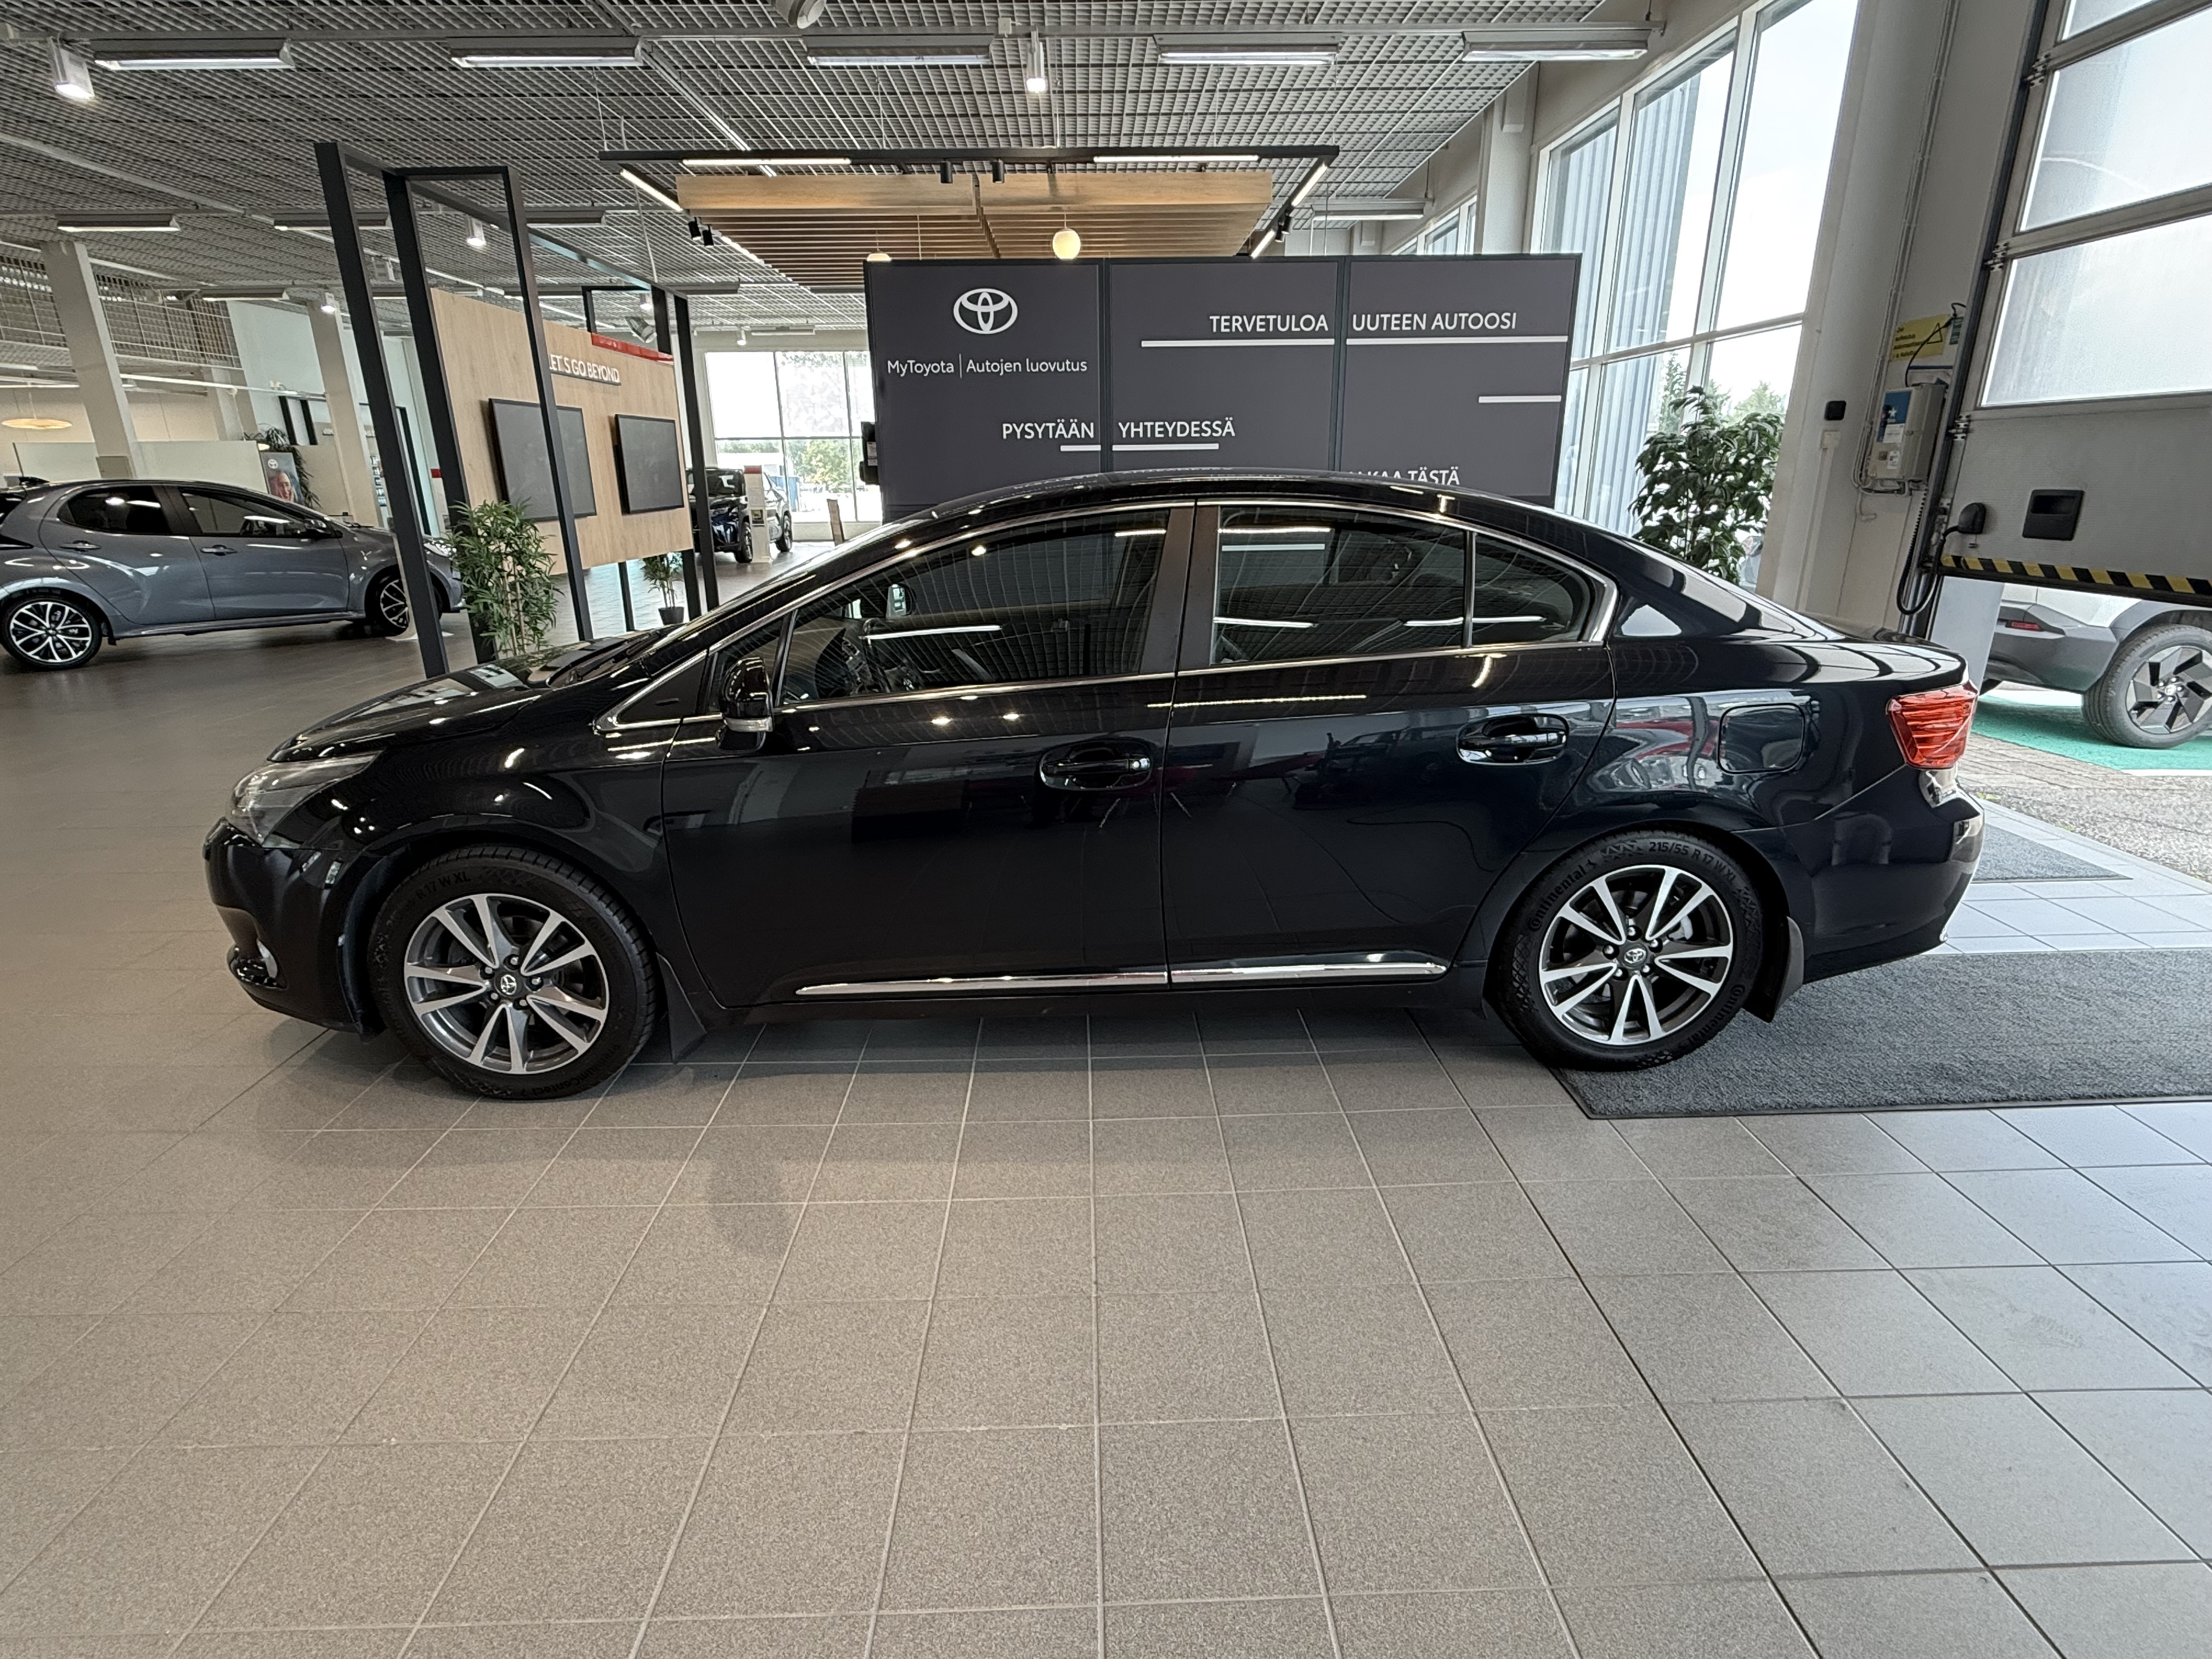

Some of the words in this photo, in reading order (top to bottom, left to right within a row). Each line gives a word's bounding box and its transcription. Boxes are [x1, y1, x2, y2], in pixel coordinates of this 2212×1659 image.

[1209, 314, 1329, 332] TERVETULOA
[1352, 313, 1427, 331] UUTEEN
[1431, 312, 1517, 330] AUTOOSI
[571, 359, 586, 377] GO
[586, 362, 620, 383] BEYOND
[887, 359, 955, 377] MyToyota
[966, 358, 1022, 376] Autojen
[1026, 358, 1087, 373] luovutus
[1002, 418, 1094, 439] PYSYTÄÄN
[1118, 417, 1235, 438] YHTEYDESSÄ
[1408, 466, 1460, 486] TÄSTÄ
[1649, 842, 1690, 855] 215/55
[1691, 848, 1701, 860] R
[1702, 854, 1715, 865] 17
[1527, 864, 1587, 932] Continental
[1688, 984, 1746, 1044] Continental
